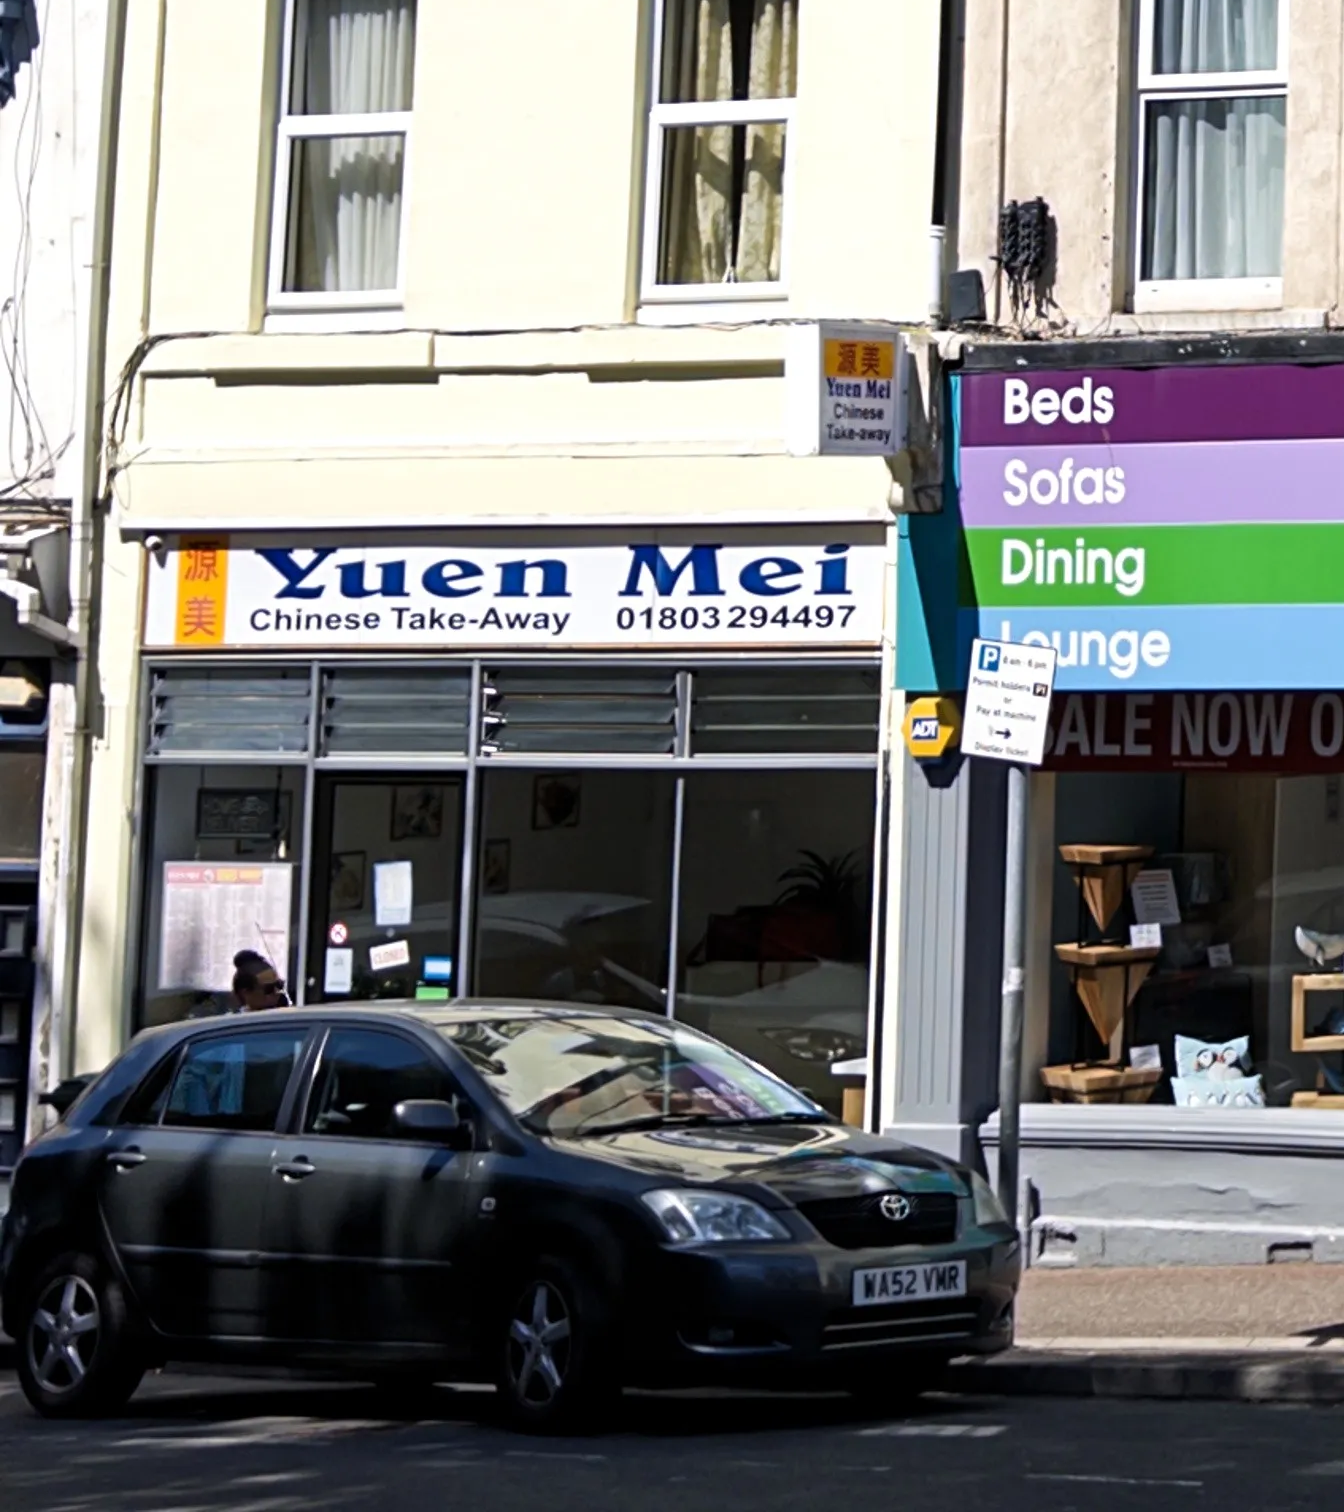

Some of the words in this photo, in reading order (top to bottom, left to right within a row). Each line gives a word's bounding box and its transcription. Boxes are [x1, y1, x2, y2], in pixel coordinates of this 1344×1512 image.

[827, 377, 861, 398] Yuen
[866, 379, 891, 399] Mei
[1004, 377, 1114, 425] Beds
[834, 402, 884, 420] Chinese
[827, 424, 891, 445] Take-away
[1003, 457, 1126, 506] Sofas
[254, 545, 572, 600] Yuen
[618, 543, 852, 597] Mei
[1002, 538, 1146, 596] Dining
[250, 607, 381, 631] Chinese
[391, 605, 571, 635] Take-Away
[976, 705, 991, 716] Pay
[1171, 692, 1294, 757] NOW
[912, 720, 938, 737] ADT
[864, 1269, 917, 1299] WA52
[924, 1265, 959, 1293] VMR
